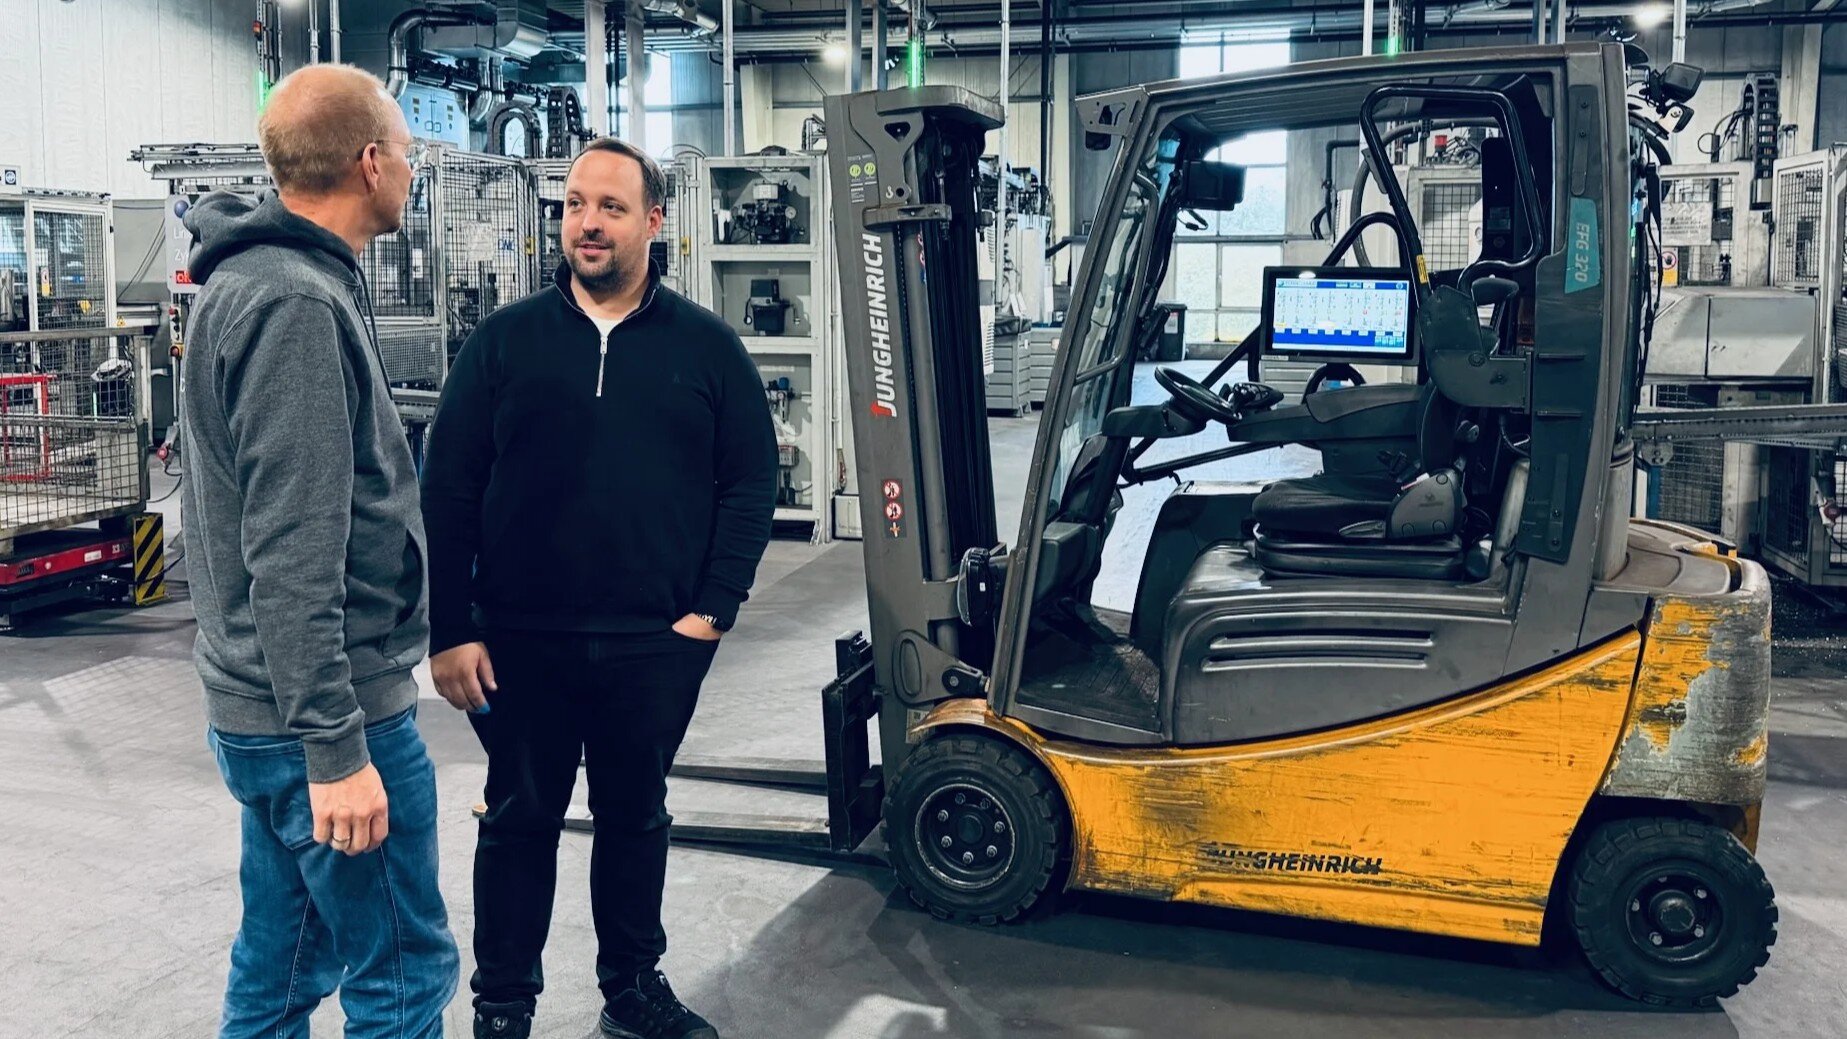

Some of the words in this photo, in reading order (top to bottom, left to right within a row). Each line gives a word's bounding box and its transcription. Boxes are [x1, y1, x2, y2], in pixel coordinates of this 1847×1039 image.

[1575, 222, 1590, 250] EFG
[1574, 253, 1589, 282] 320
[862, 233, 897, 417] JUNGHEINRICH
[1206, 848, 1382, 875] UNGHEINRICH
